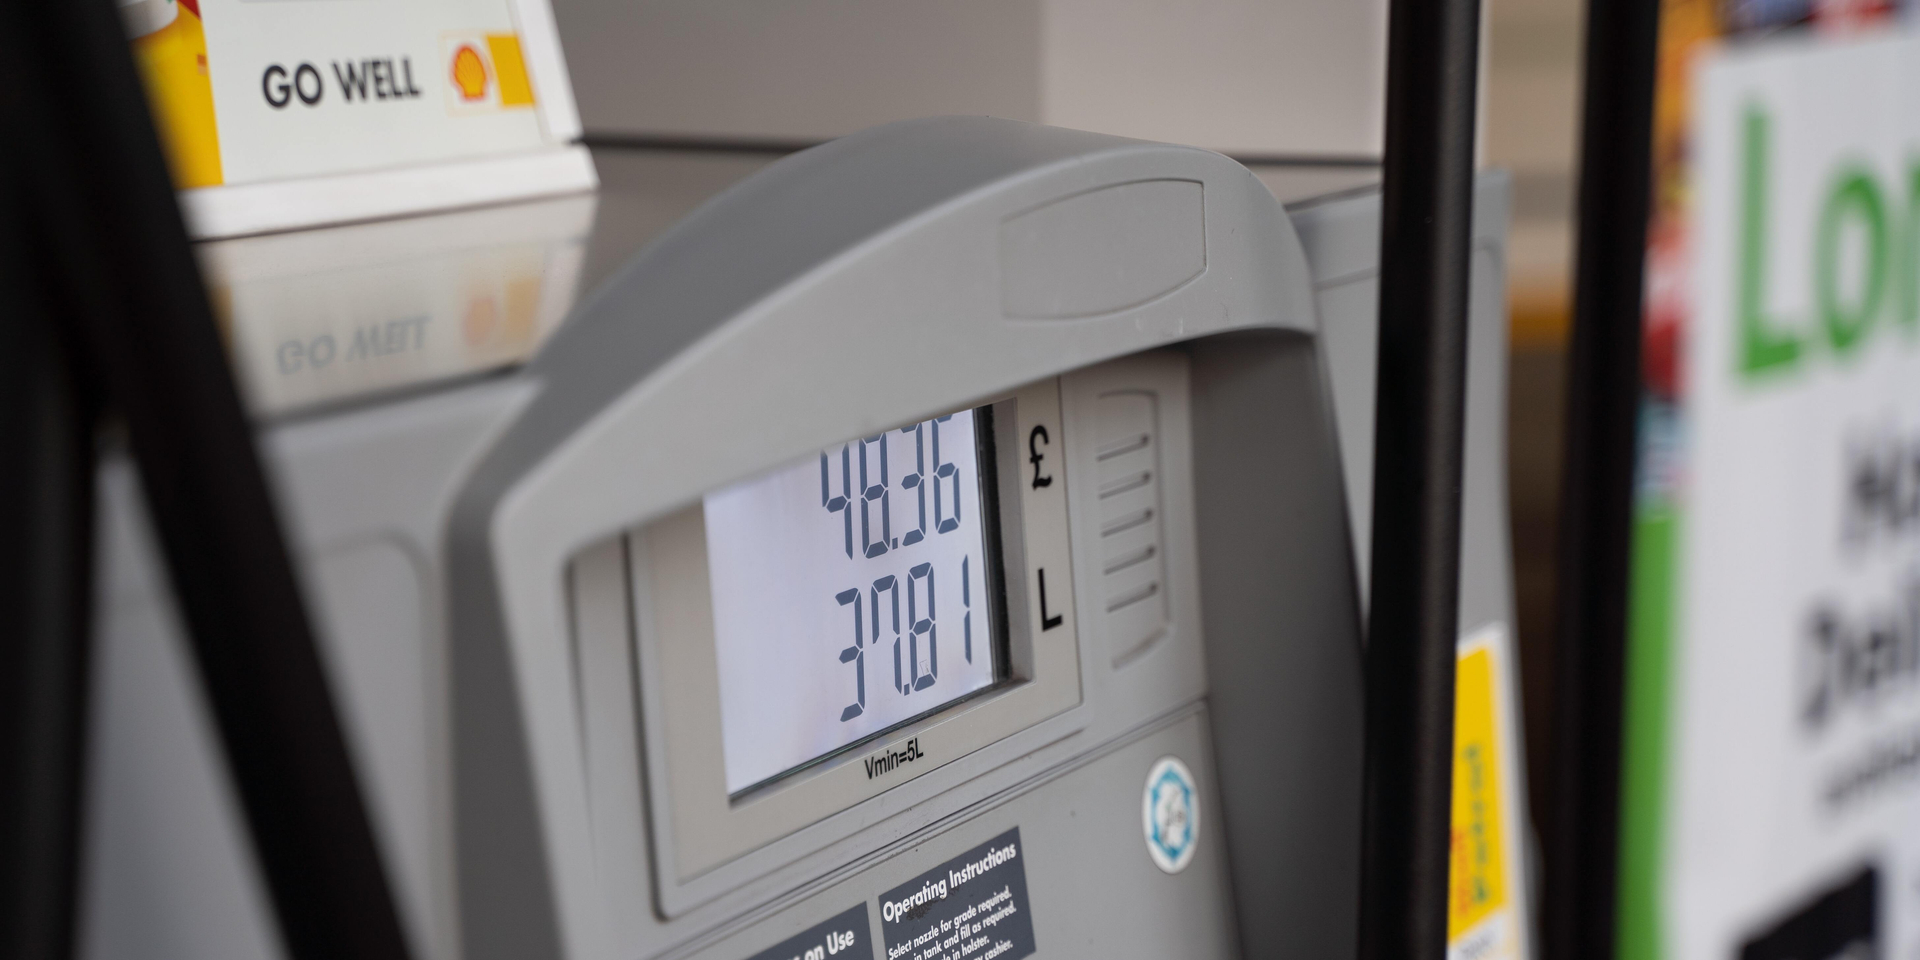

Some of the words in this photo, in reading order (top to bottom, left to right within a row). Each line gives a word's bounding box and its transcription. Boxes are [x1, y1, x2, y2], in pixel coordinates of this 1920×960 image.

[262, 62, 323, 108] GO
[331, 57, 421, 102] WELL
[820, 414, 961, 560] 48.36
[1029, 425, 1053, 491] £
[1037, 567, 1063, 632] L
[834, 553, 972, 722] 37.81
[864, 737, 924, 780] Vmin=5L
[883, 878, 948, 923] Operating
[949, 843, 1017, 888] Instructions
[826, 930, 855, 955] Use
[888, 940, 912, 960] Select
[913, 925, 939, 948] nozzle
[940, 919, 952, 934] for
[954, 904, 977, 929] grade
[978, 884, 1012, 914] required.
[923, 941, 943, 960] tank
[943, 930, 959, 950] and
[960, 923, 971, 941] fill
[972, 921, 982, 934] as
[982, 900, 1017, 929] required.
[951, 948, 961, 960] in
[961, 935, 990, 956] holster.
[984, 939, 1013, 960] cashier.
